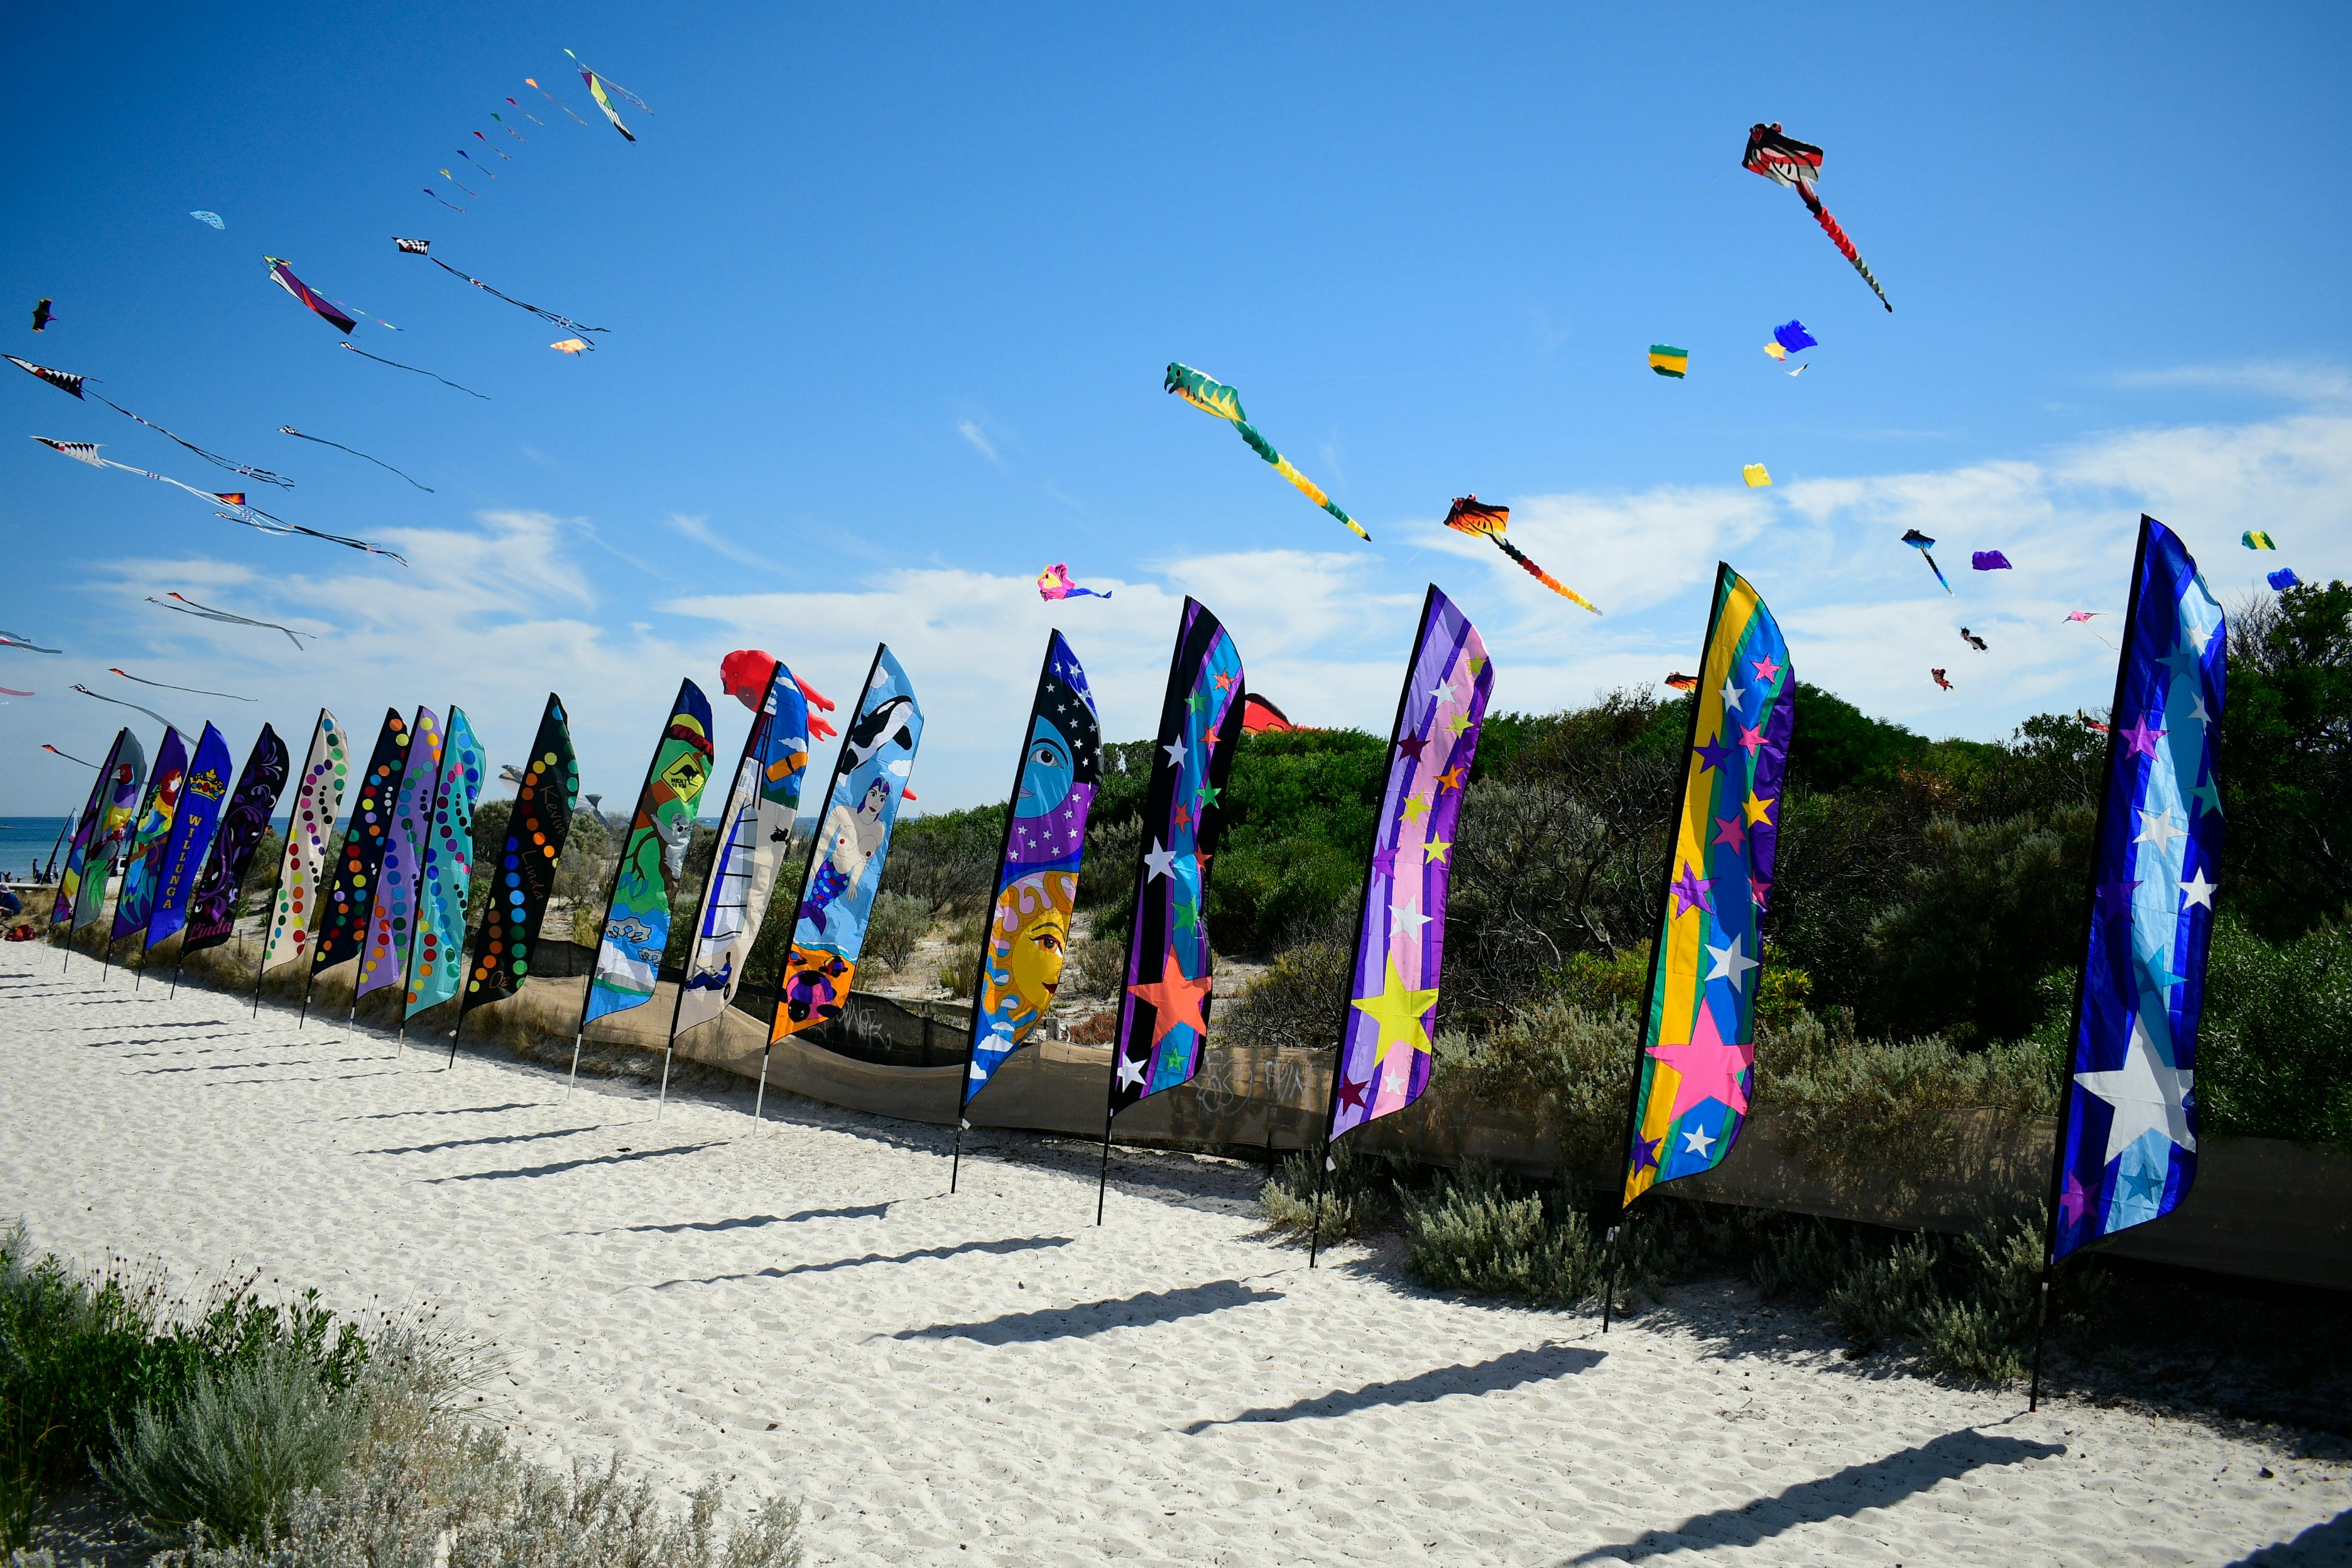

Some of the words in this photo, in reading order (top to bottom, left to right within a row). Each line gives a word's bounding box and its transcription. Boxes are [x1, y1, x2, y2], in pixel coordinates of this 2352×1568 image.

[162, 814, 202, 908] WILLUNGA
[522, 849, 545, 901] Linda
[188, 916, 232, 942] Linda
[489, 970, 510, 988] Oz
